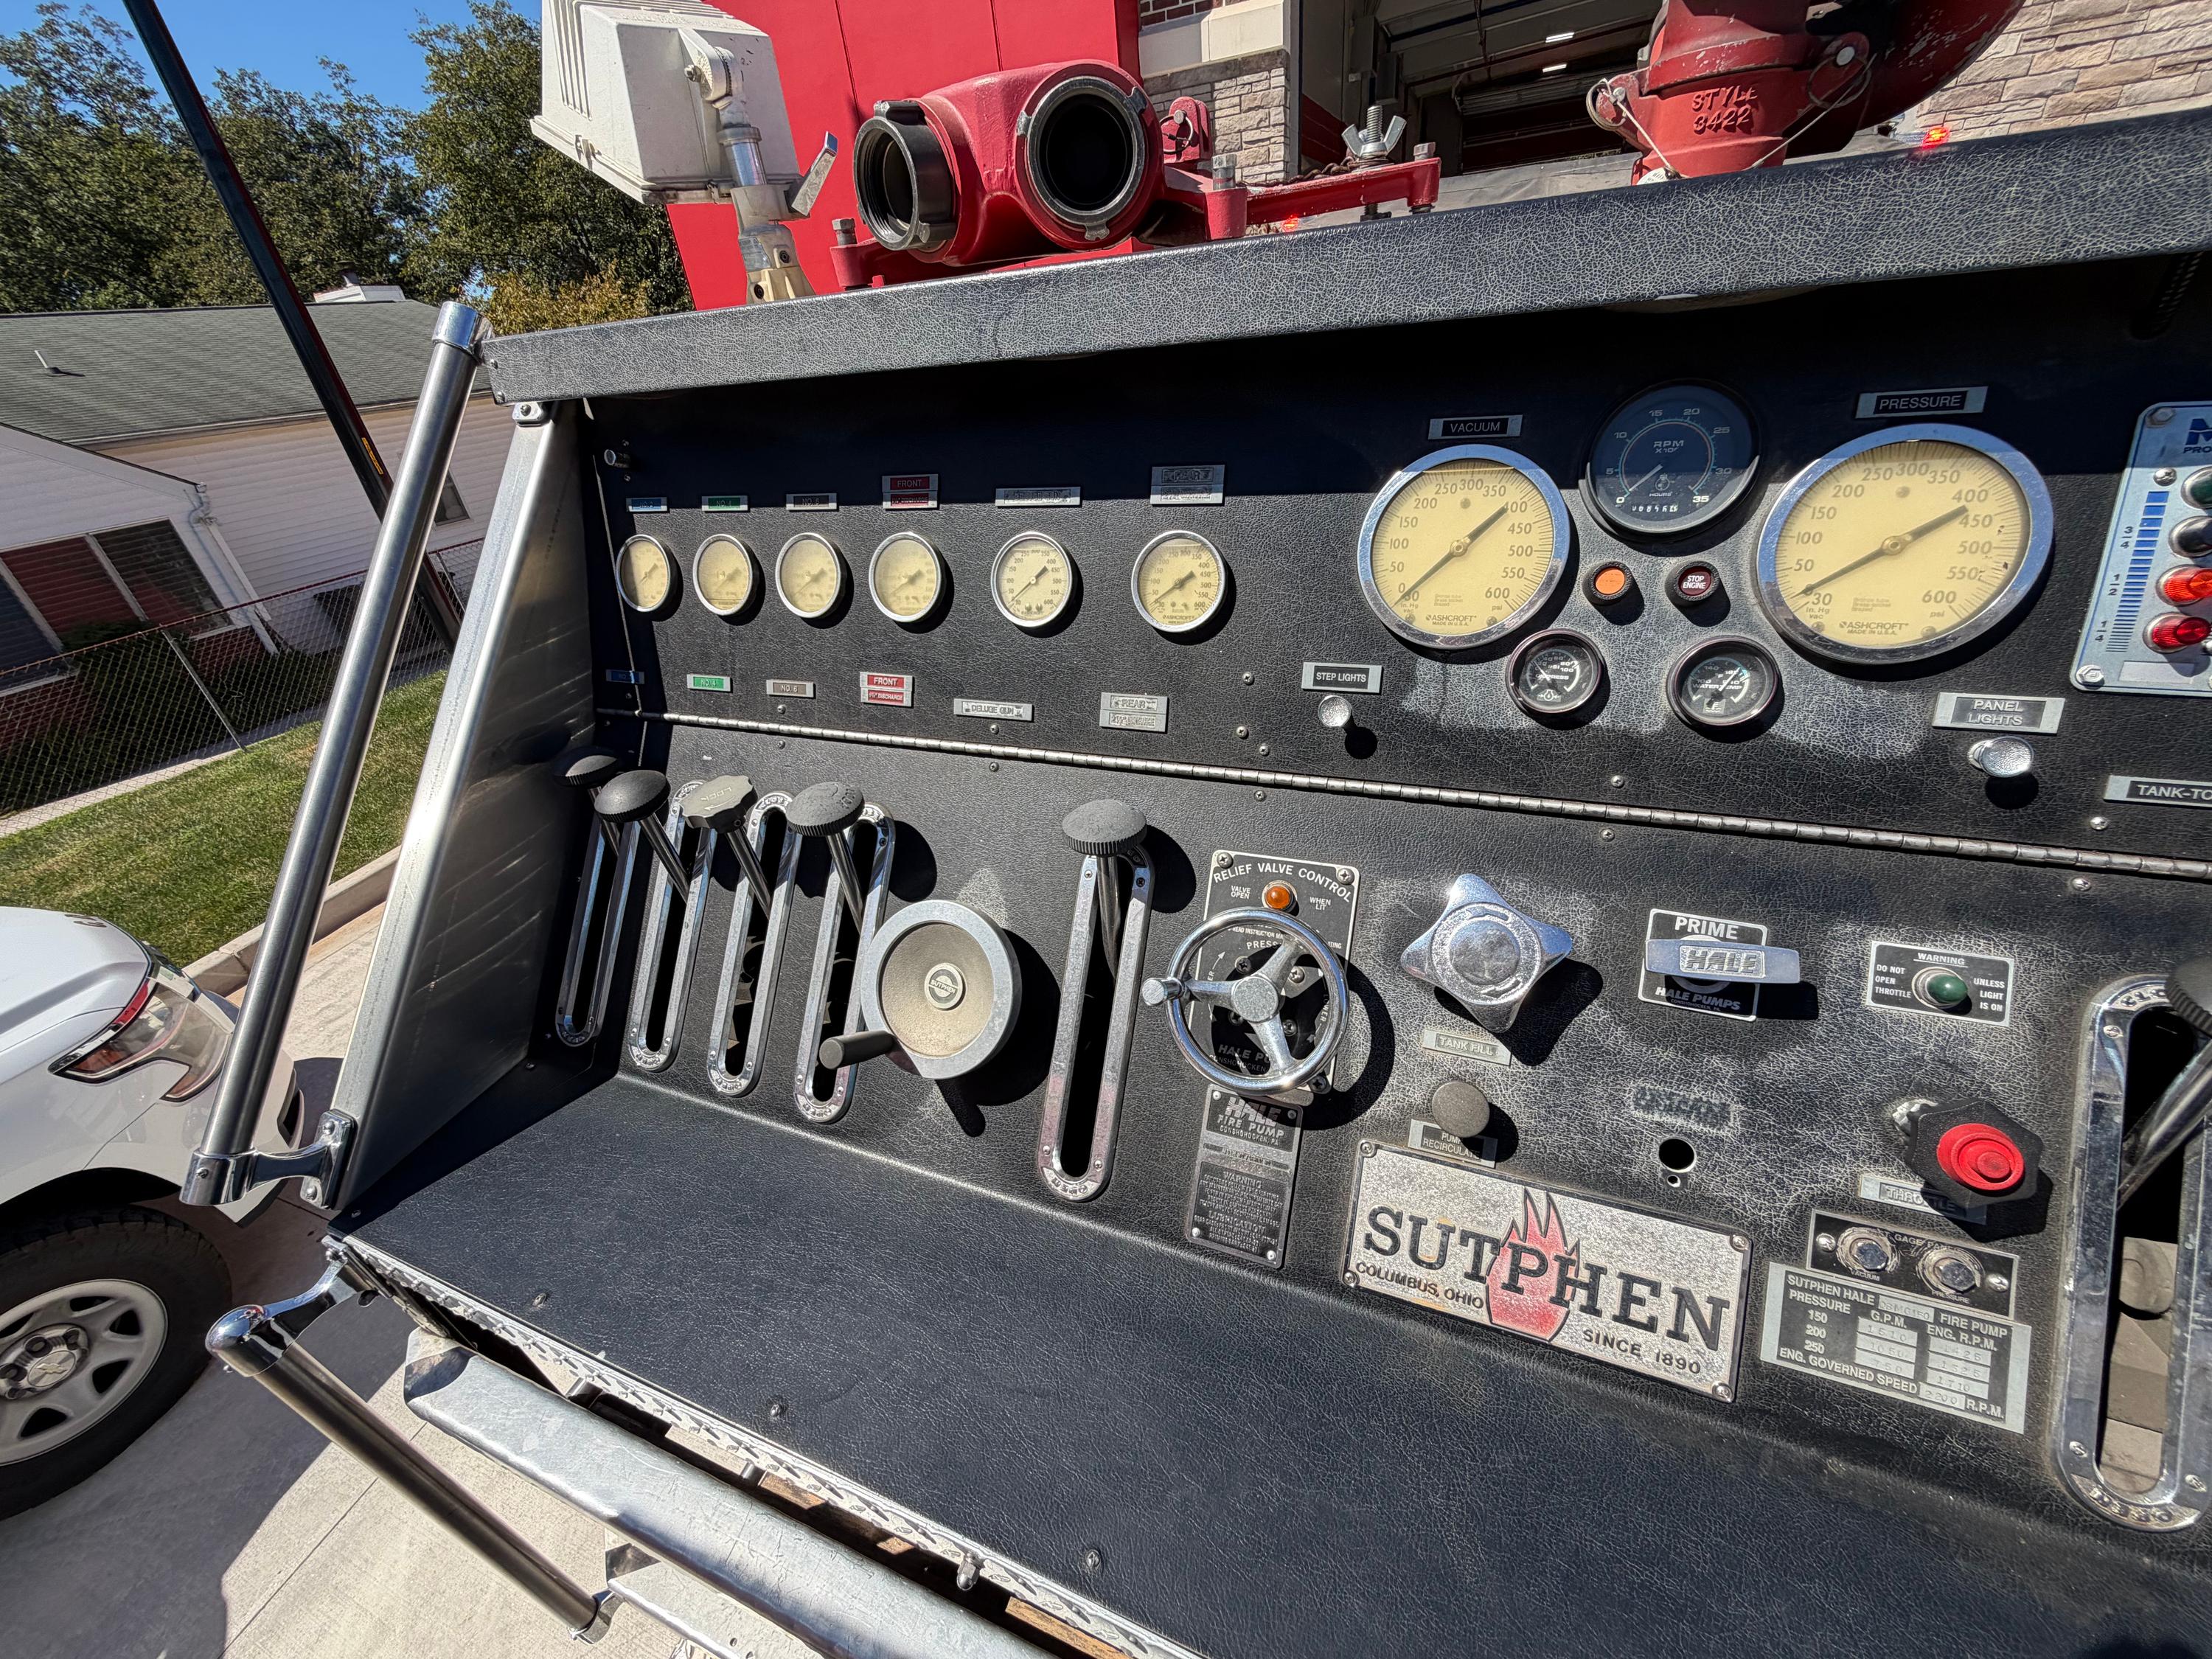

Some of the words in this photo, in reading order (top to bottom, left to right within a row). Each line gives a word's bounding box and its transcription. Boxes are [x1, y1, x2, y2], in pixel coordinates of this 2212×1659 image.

[1692, 106, 1754, 134] 3422
[1879, 396, 1961, 411] PRESSURE
[1450, 422, 1500, 433] VACUUM
[1862, 467, 1893, 481] 250
[1896, 462, 1929, 476] 300
[897, 479, 922, 487] FRONT
[1927, 470, 1960, 484] 350
[1435, 484, 1457, 495] 250
[1459, 479, 1484, 490] 300
[1483, 485, 1506, 497] 350
[1832, 484, 1864, 498] 200
[1952, 490, 1988, 502] 400
[1413, 498, 1437, 509] 200
[1505, 501, 1527, 512] 400
[1811, 507, 1836, 520] 150
[1399, 516, 1418, 528] 150
[1959, 515, 1993, 528] 450
[1508, 523, 1531, 535] 450
[1390, 538, 1408, 549] 100
[1795, 532, 1822, 545] 100
[1509, 546, 1533, 557] 500
[1958, 540, 1991, 554] 500
[1390, 562, 1404, 572] 50
[1794, 559, 1814, 571] 50
[1501, 567, 1525, 579] 550
[1947, 566, 1978, 580] 550
[1485, 588, 1509, 599] 600
[1812, 593, 1832, 605] 30
[1921, 590, 1956, 604] 600
[1846, 622, 1904, 630] ASHCROFT
[874, 677, 897, 686] FRONT
[1316, 672, 1336, 681] STEP
[1338, 673, 1366, 683] LIGHTS
[877, 692, 903, 701] DISCHARGE
[971, 705, 997, 714] DELUGE
[1973, 700, 2024, 712] PANEL
[1967, 713, 2023, 726] LIGHTS
[1213, 863, 1253, 883] RELIEF
[1257, 863, 1294, 875] VALVE
[1298, 868, 1352, 903] CONTROL
[1231, 885, 1251, 894] VALVE
[1231, 891, 1250, 900] OPEN
[1310, 897, 1331, 906] WHEN
[1245, 928, 1274, 937] INSTRUCTION
[1674, 916, 1739, 940] PRIME
[1685, 950, 1757, 973] HALE
[1917, 952, 1965, 965] WARNING
[1890, 966, 1905, 974] NOT
[1875, 975, 1896, 985] OPEN
[1973, 978, 2005, 989] UNLESS
[931, 979, 957, 994] SUTPHEN
[1874, 987, 1912, 998] THROTTLE
[1655, 987, 1690, 1001] HALE
[1692, 993, 1741, 1011] PUMPS
[1980, 990, 2004, 1001] LIGHT
[1990, 1003, 2003, 1012] ON
[1219, 1044, 1251, 1059] HALE
[1440, 1037, 1468, 1051] TANK
[1471, 1043, 1494, 1056] FILL
[1225, 1097, 1281, 1127] HALE
[1217, 1114, 1242, 1128] FIRE
[1249, 1122, 1284, 1138] PUMP
[1223, 1172, 1262, 1189] WARNING
[1894, 1234, 1923, 1246] GAGE
[1363, 1206, 1729, 1351] SUTPHEN
[1851, 1270, 1880, 1281] VACUUM
[1355, 1261, 1441, 1298] COLUMBUS,
[1444, 1284, 1484, 1310] OHIO
[1931, 1290, 1970, 1304] PRESSURE
[1787, 1274, 1841, 1296] SUTPHEN
[1843, 1290, 1875, 1306] HALE
[1940, 1312, 1968, 1330] FIRE
[1972, 1321, 2008, 1338] PUMP
[1789, 1290, 1851, 1314] PRESSURE
[1871, 1310, 1907, 1328] G.P.M.
[1926, 1324, 1956, 1340] ENG.
[1959, 1332, 1997, 1351] R.P.M.
[1808, 1310, 1828, 1324] 150
[1806, 1325, 1827, 1339] 200
[1583, 1328, 1641, 1357] SINCE
[1655, 1349, 1702, 1375] 1890
[1804, 1340, 1825, 1354] 250
[1780, 1347, 1806, 1364] ENG.
[1809, 1354, 1874, 1381] GOVERNED
[1876, 1374, 1918, 1394] SPEED
[1925, 1389, 1958, 1405] 2200
[1966, 1399, 2005, 1419] R.P.M.
